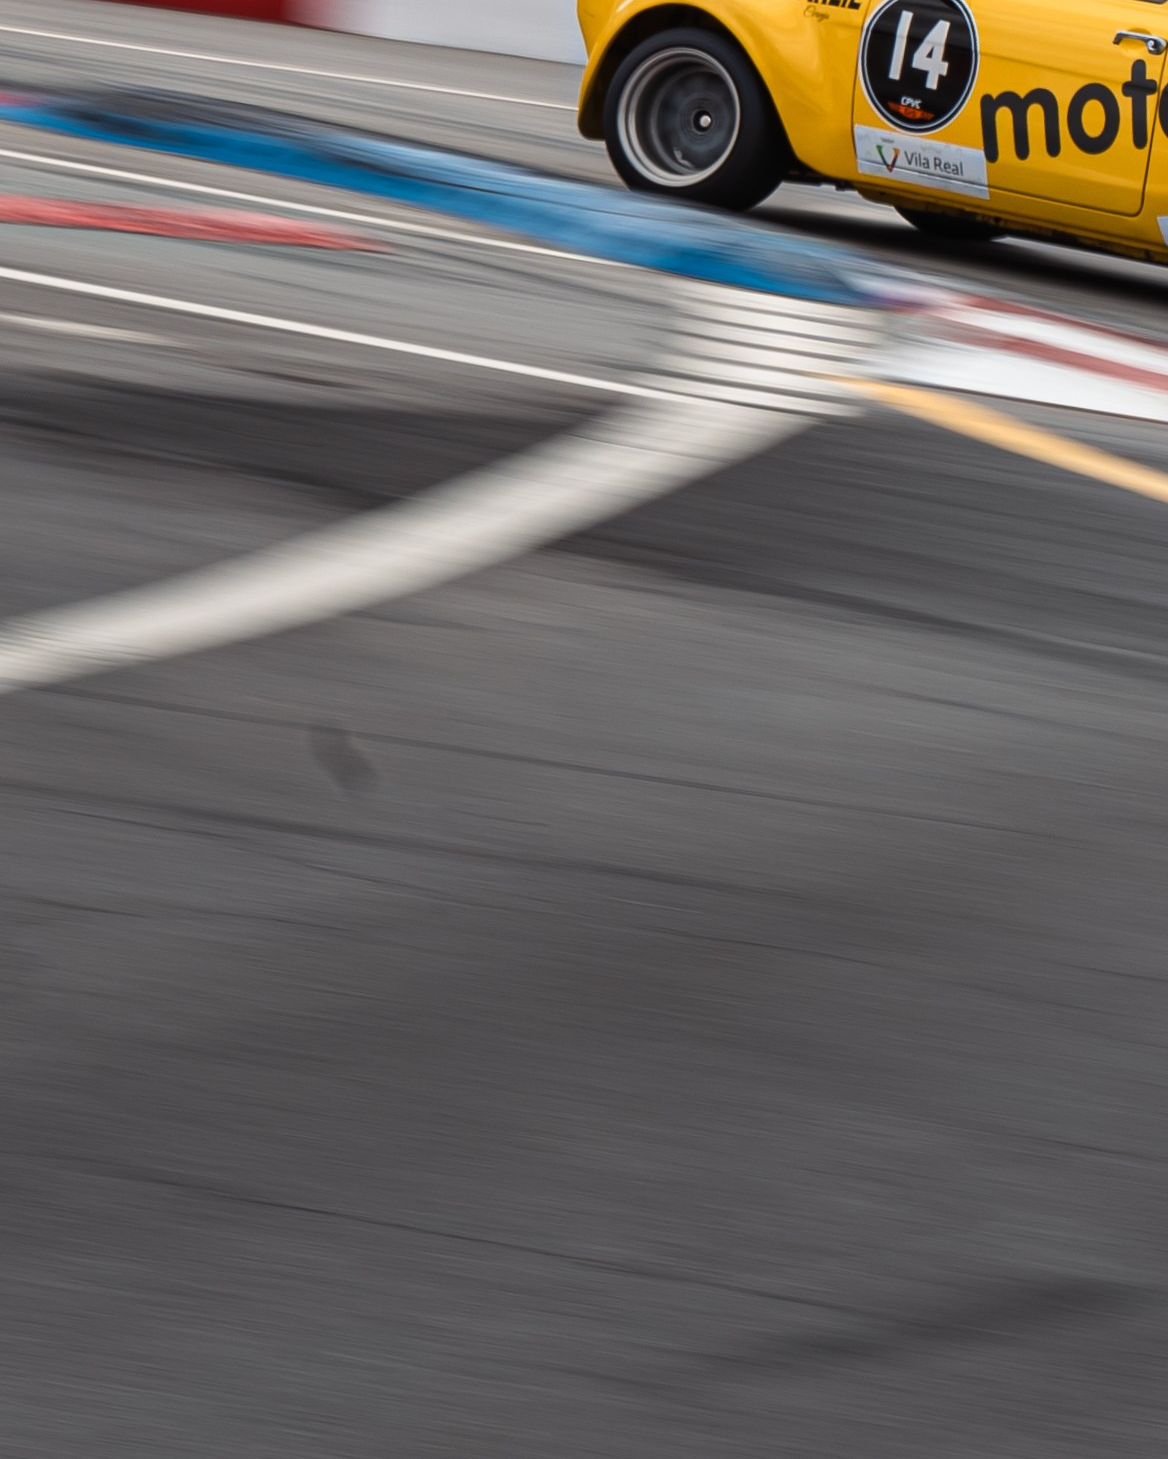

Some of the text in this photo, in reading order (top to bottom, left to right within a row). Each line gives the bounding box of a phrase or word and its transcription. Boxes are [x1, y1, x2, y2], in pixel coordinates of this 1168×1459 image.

[889, 10, 951, 90] 14
[904, 150, 964, 176] Vila Real
